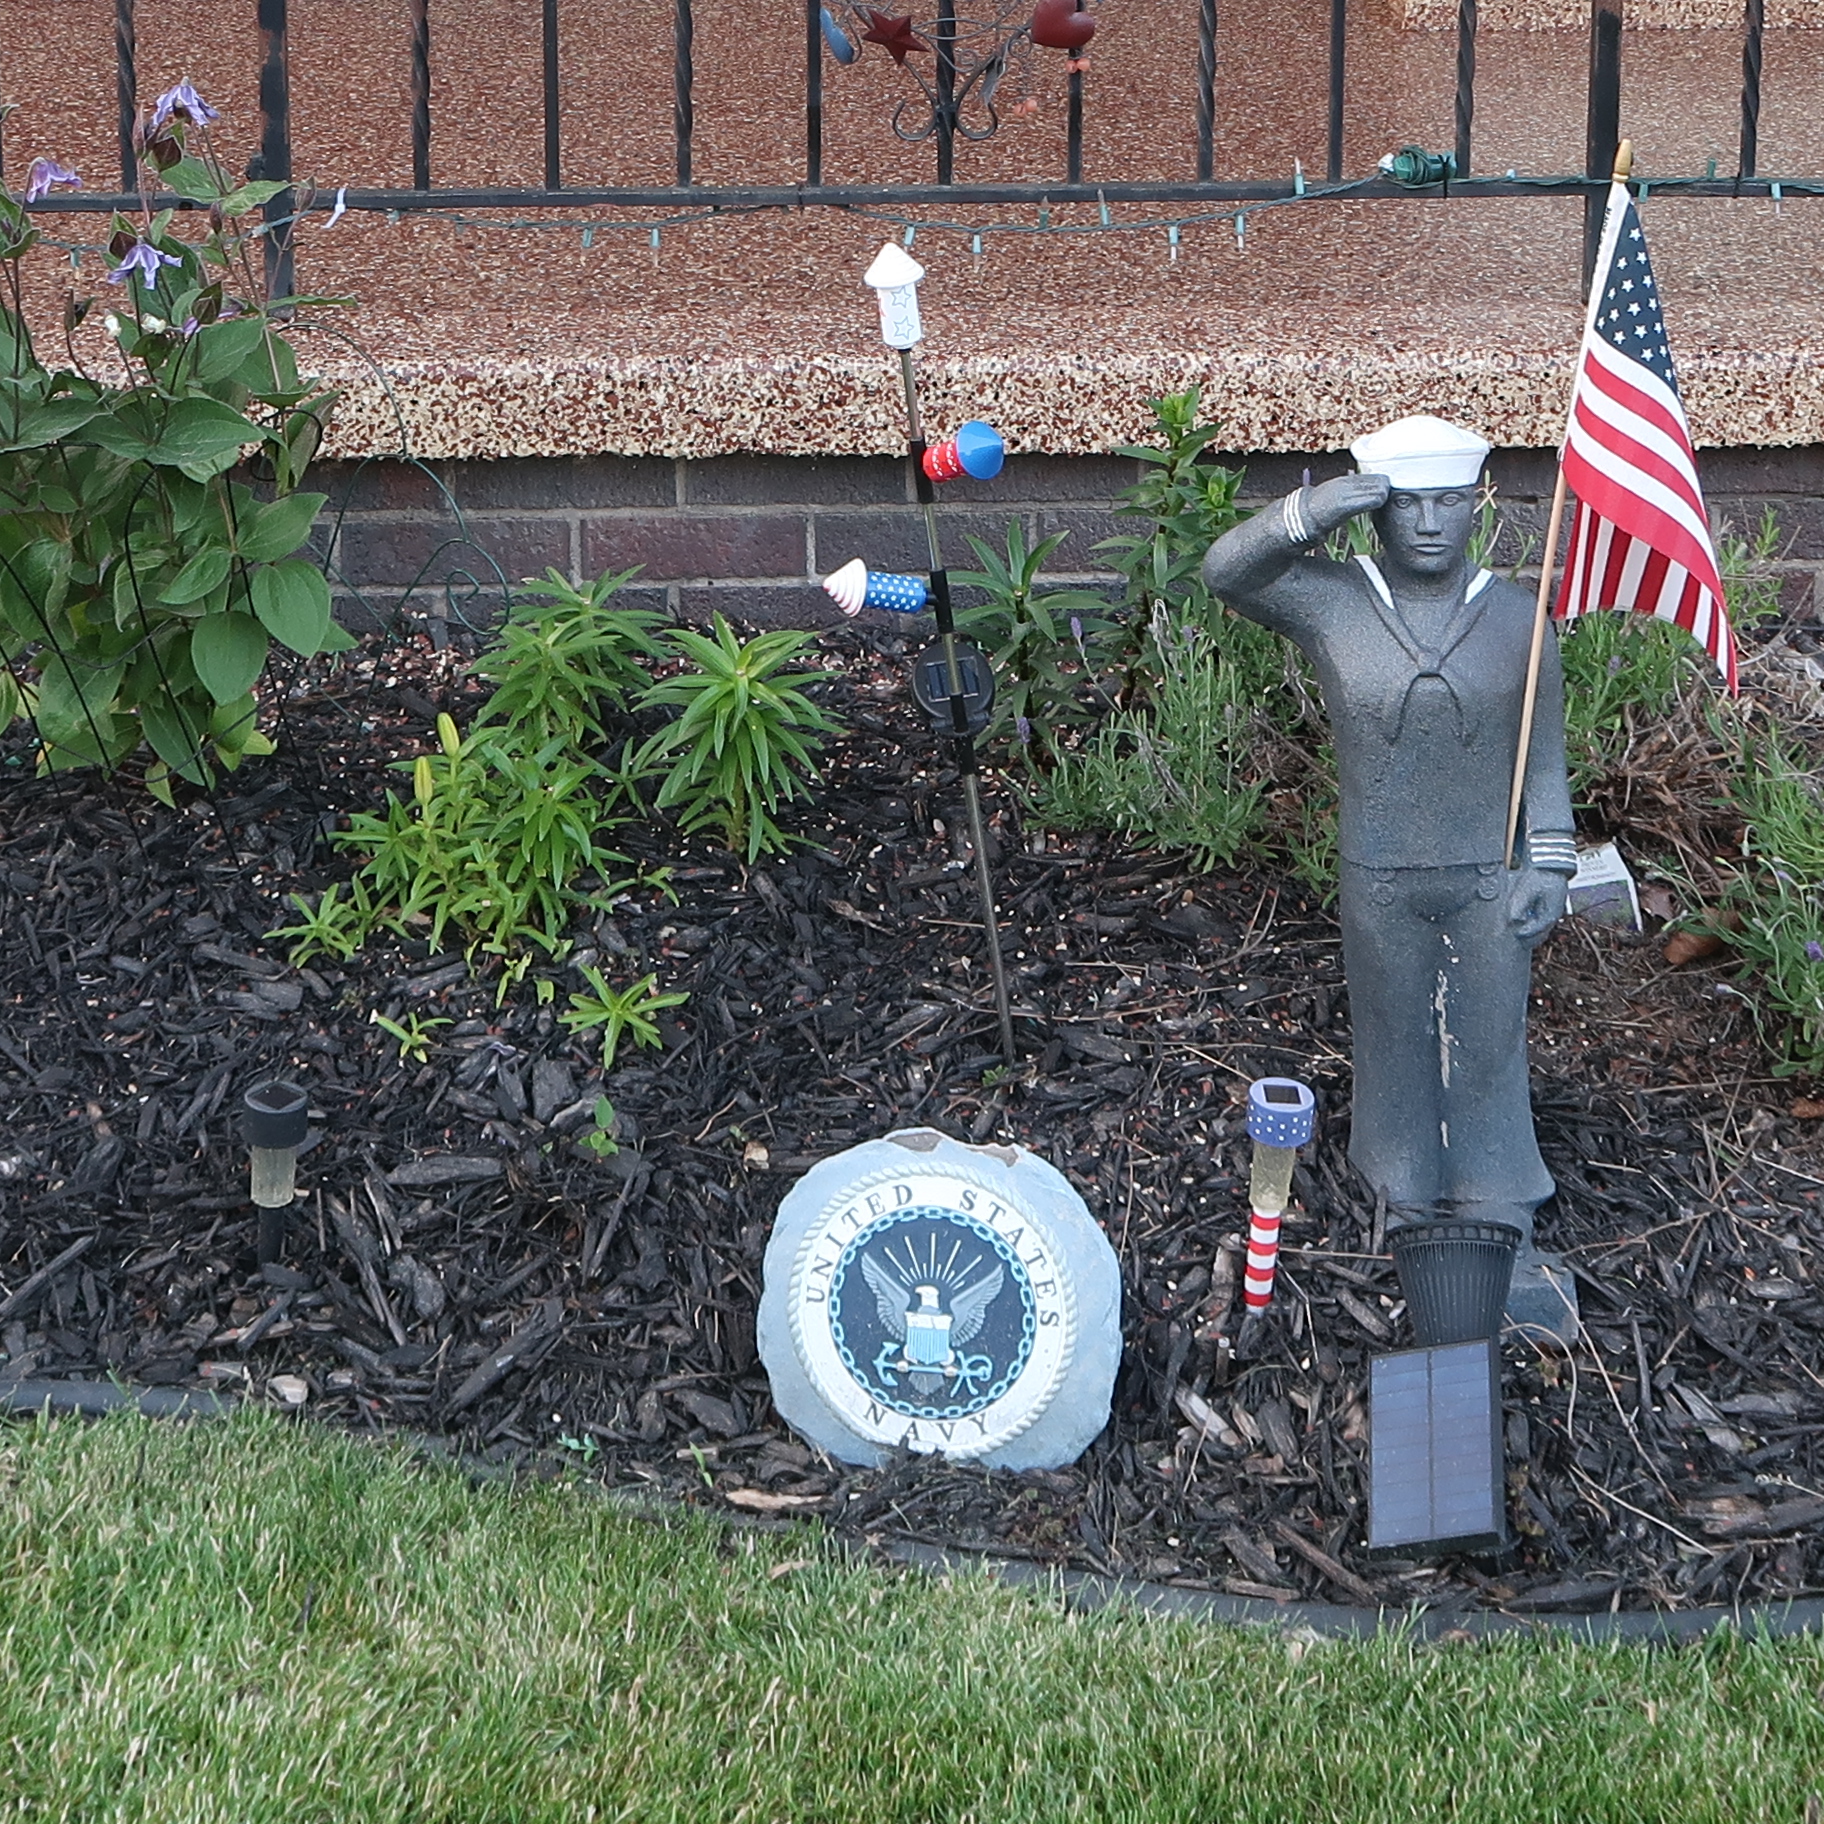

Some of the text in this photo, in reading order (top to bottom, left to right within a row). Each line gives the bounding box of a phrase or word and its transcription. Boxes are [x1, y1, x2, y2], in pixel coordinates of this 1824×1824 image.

[806, 1184, 1060, 1328] UNITED STATES
[862, 1402, 990, 1443] NAVY
